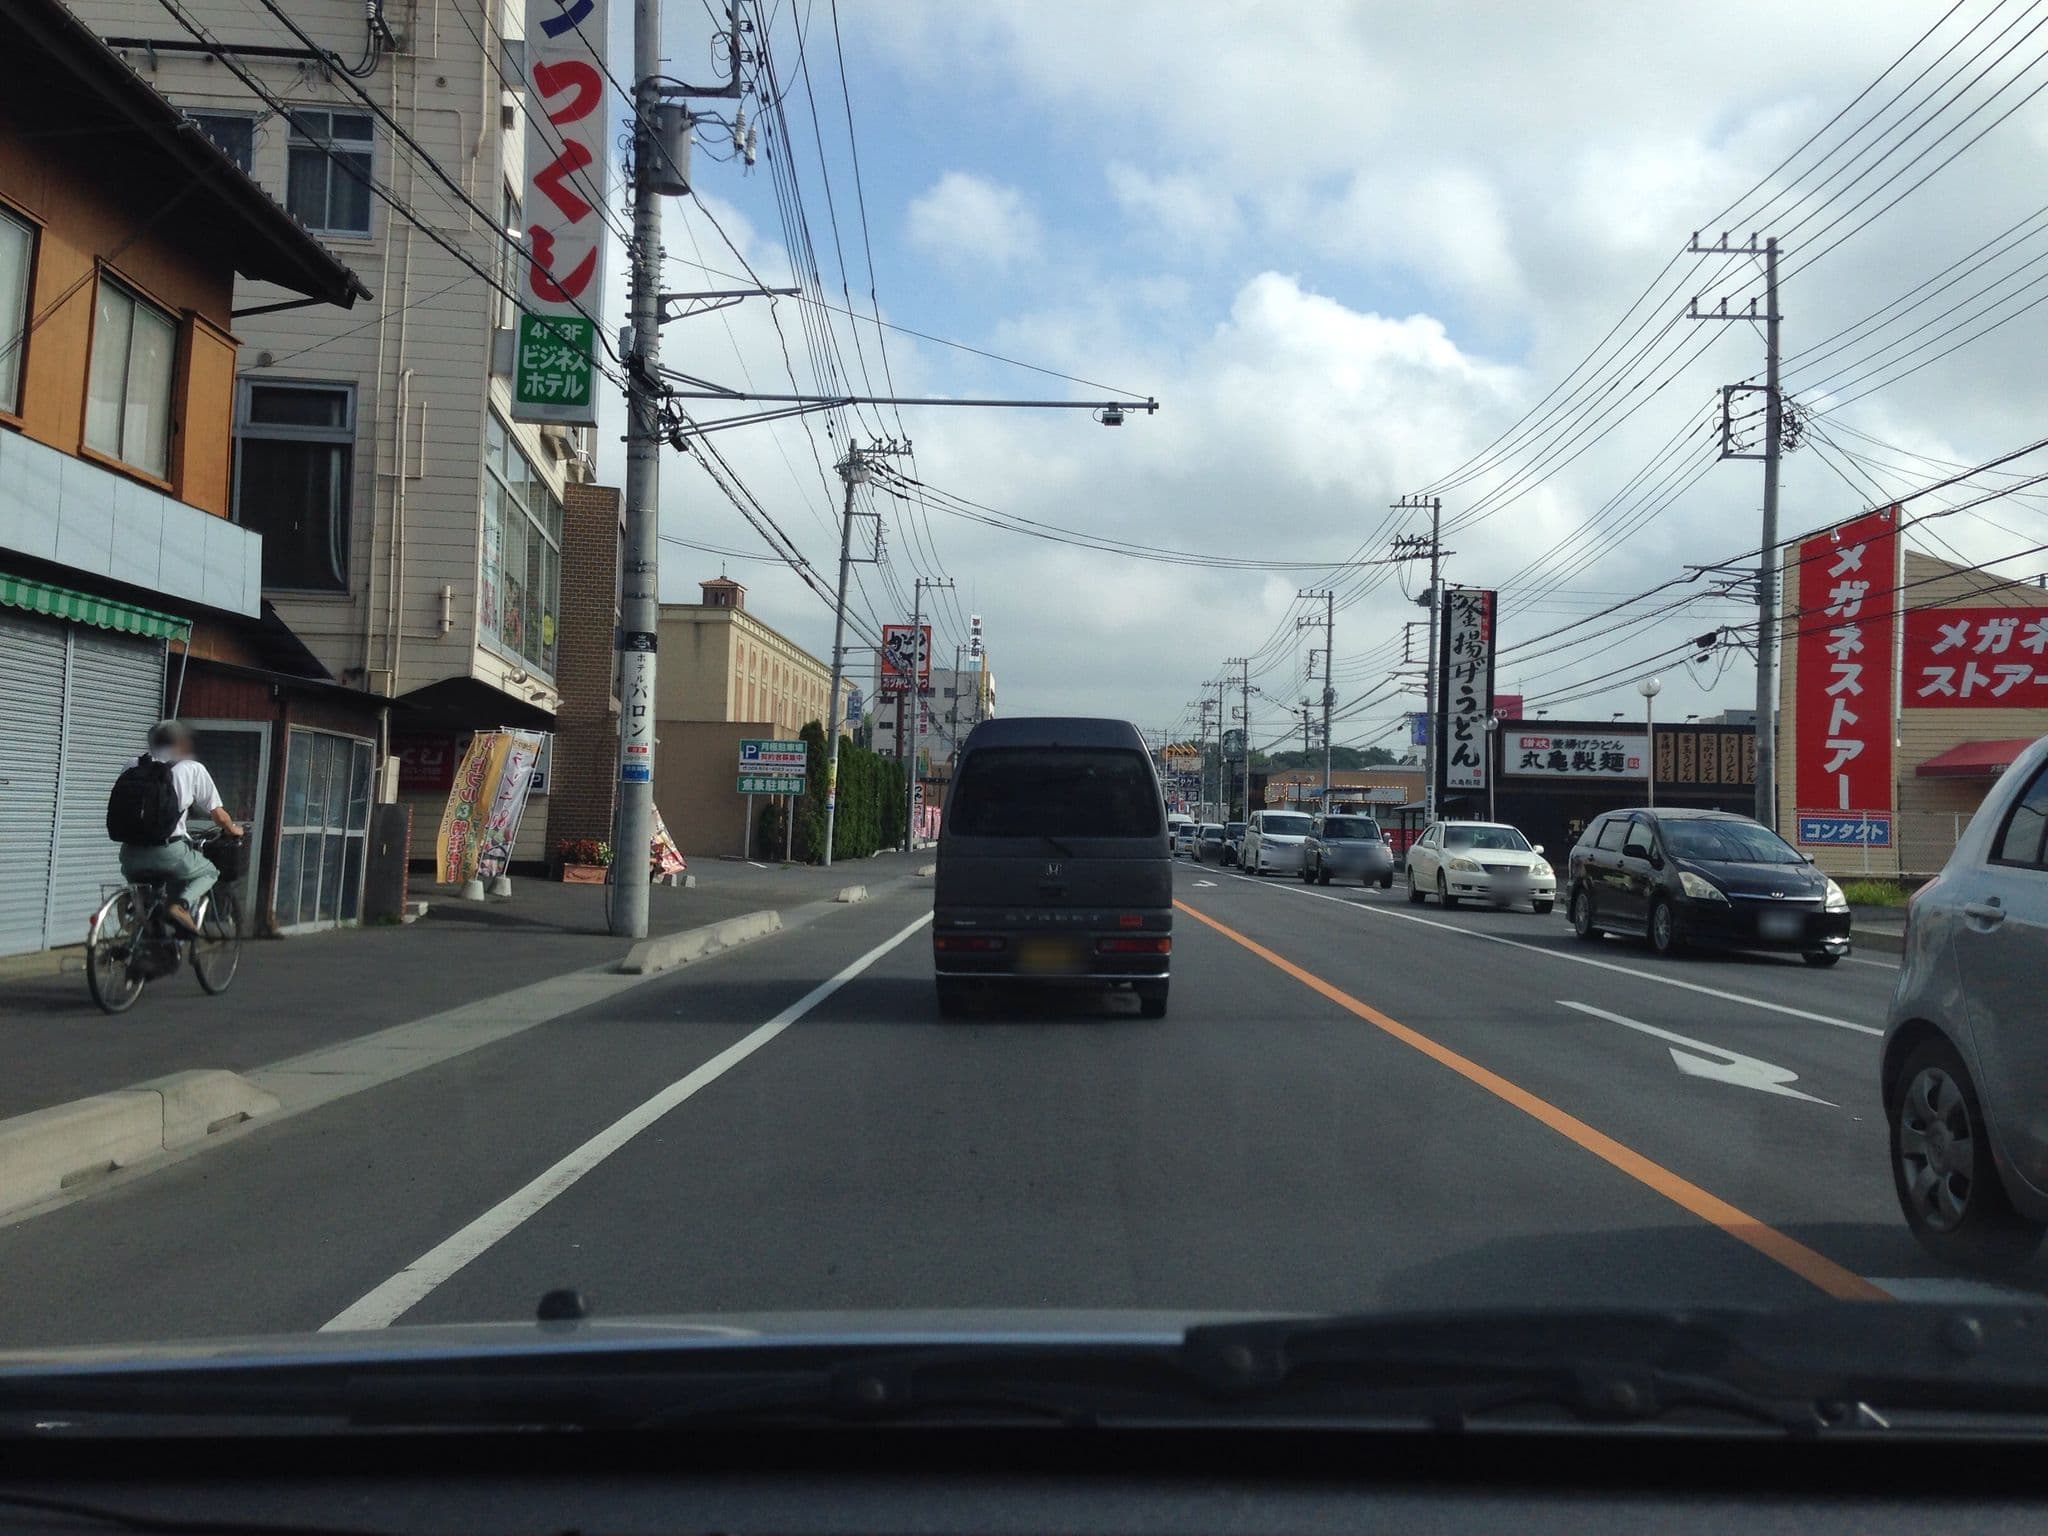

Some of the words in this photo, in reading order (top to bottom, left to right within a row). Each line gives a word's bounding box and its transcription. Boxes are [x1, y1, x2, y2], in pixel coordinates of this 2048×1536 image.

[528, 60, 603, 303] つくし
[522, 344, 588, 372] ビジネス
[523, 372, 584, 398] ホテル
[1451, 592, 1486, 768] 釜揚げうどん
[1824, 543, 1870, 810] メガネストアー
[1520, 751, 1626, 772] 丸亀製麺
[1805, 823, 1886, 841] コンタクト
